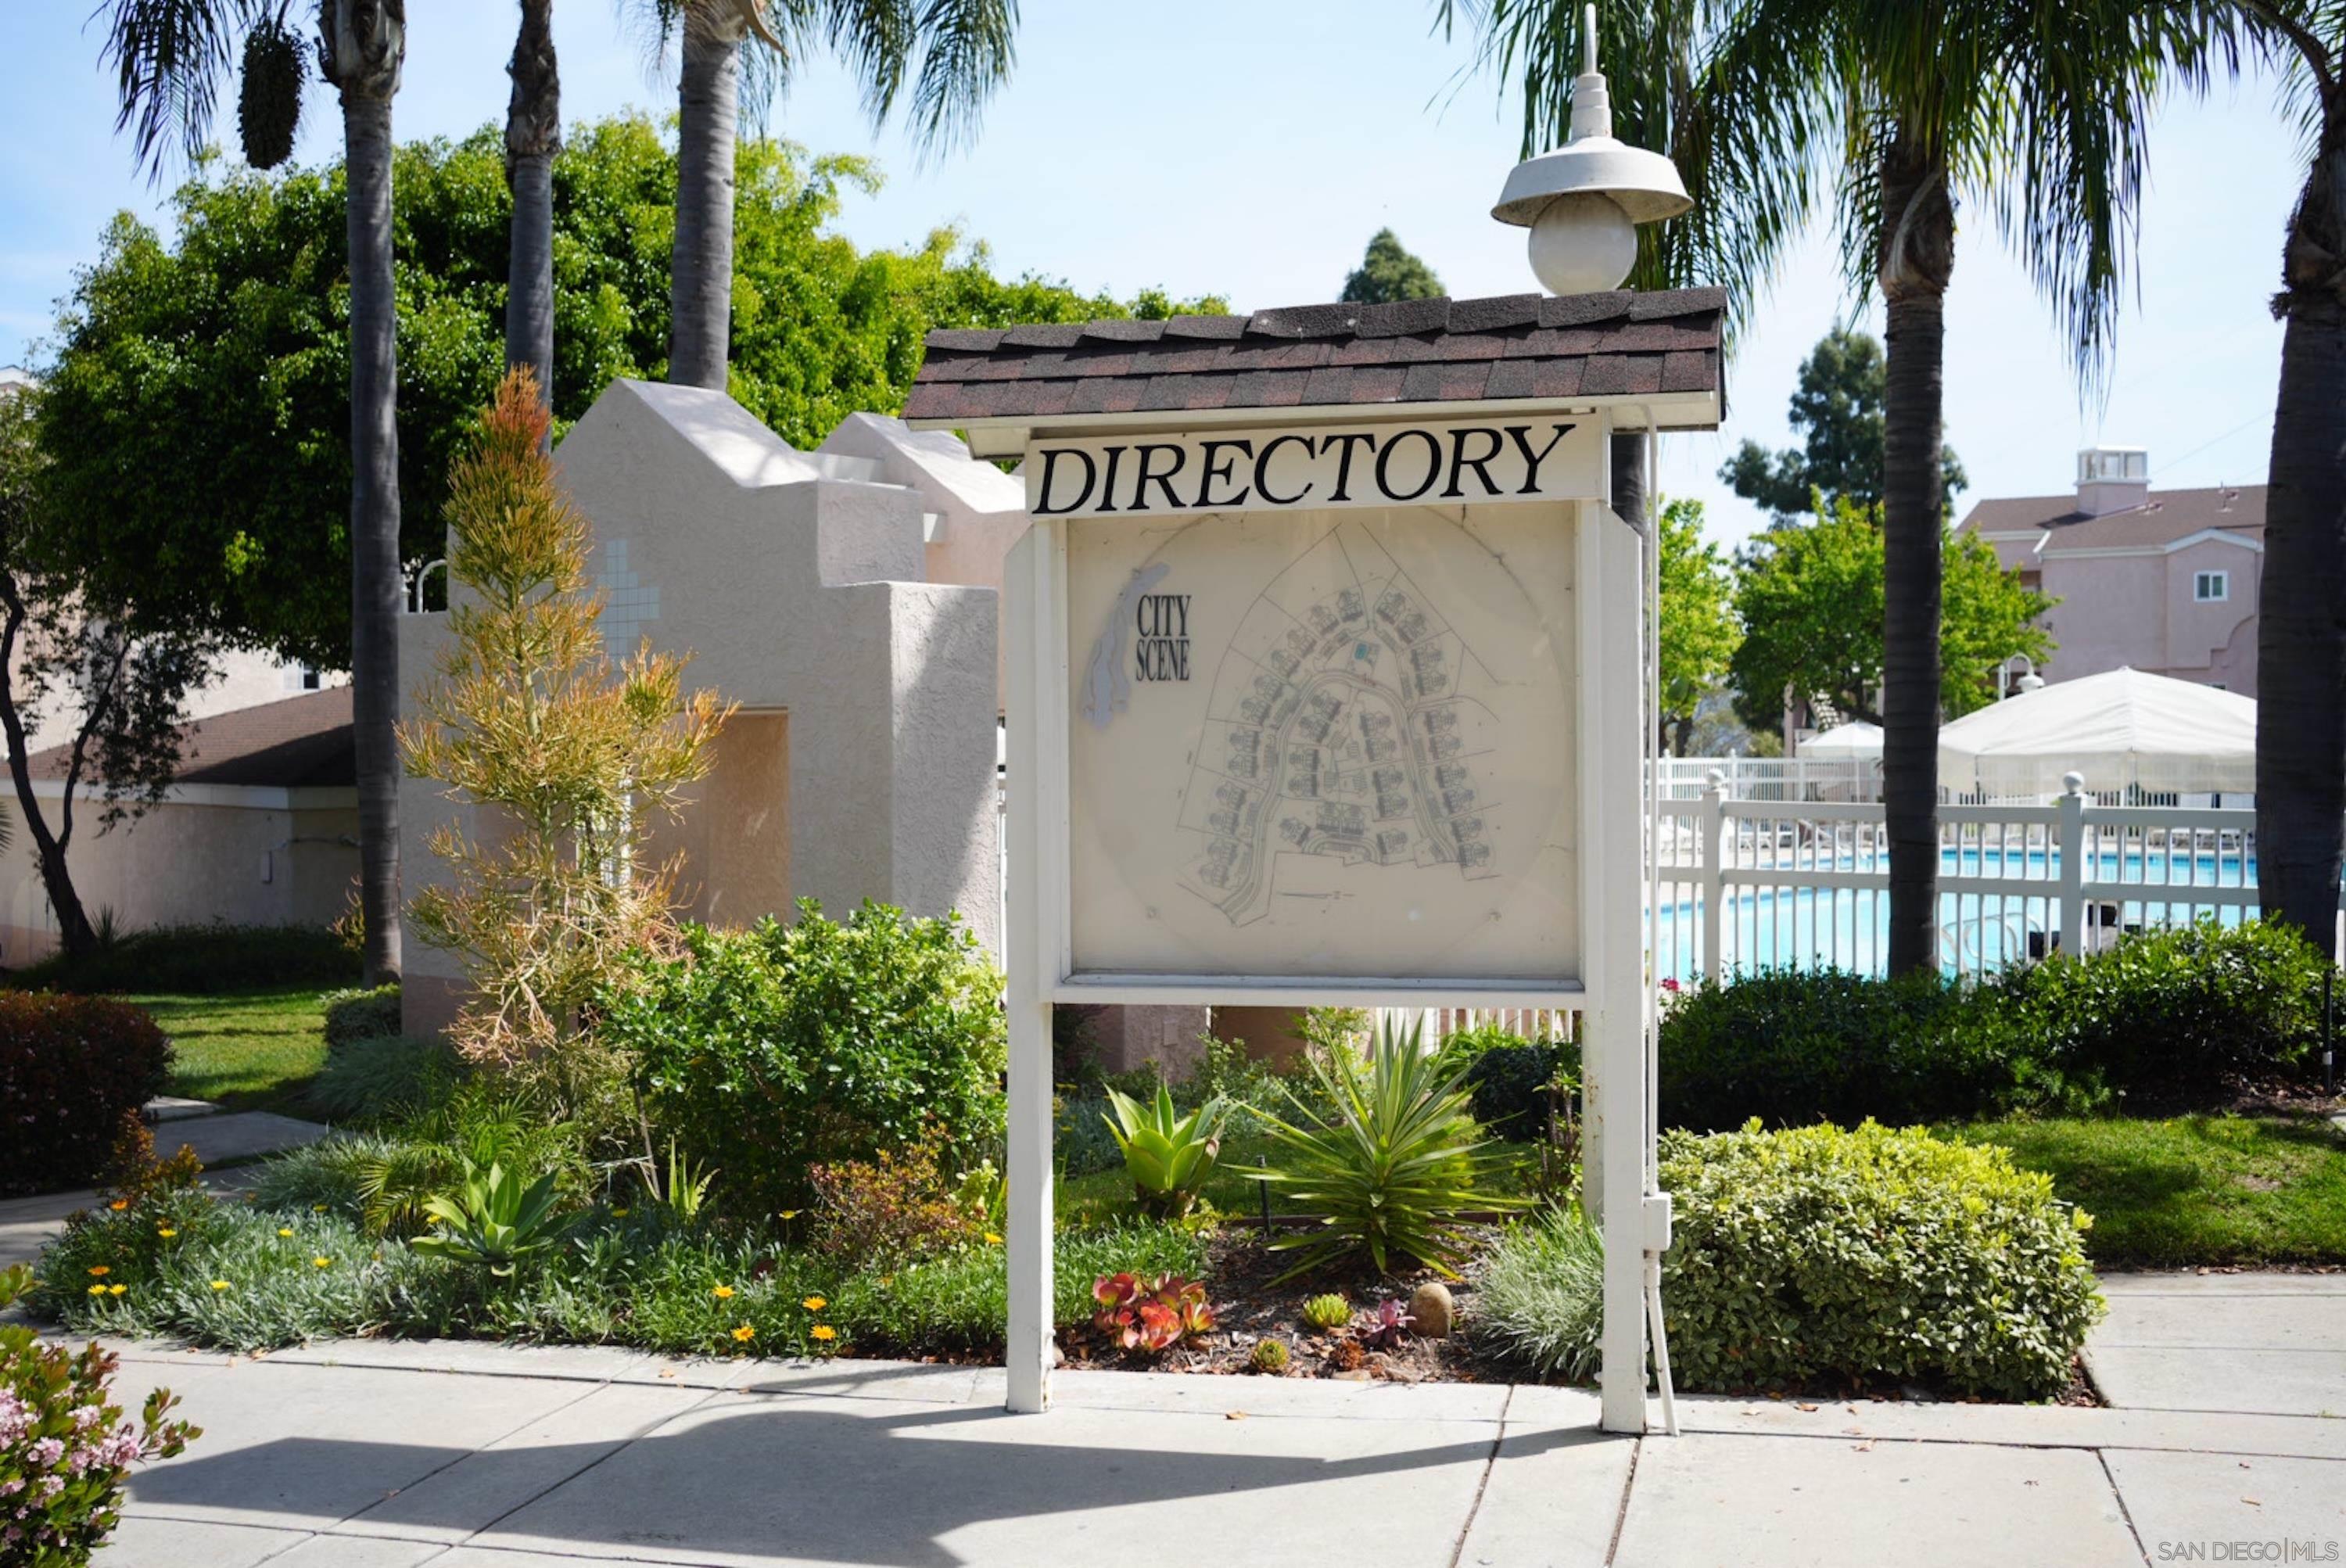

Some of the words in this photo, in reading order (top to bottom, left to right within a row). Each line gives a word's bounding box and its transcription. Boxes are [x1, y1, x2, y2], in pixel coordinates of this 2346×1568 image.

[1032, 423, 1576, 515] DIRECTORY
[1137, 594, 1192, 637] CITY
[1135, 638, 1189, 682] SCENE
